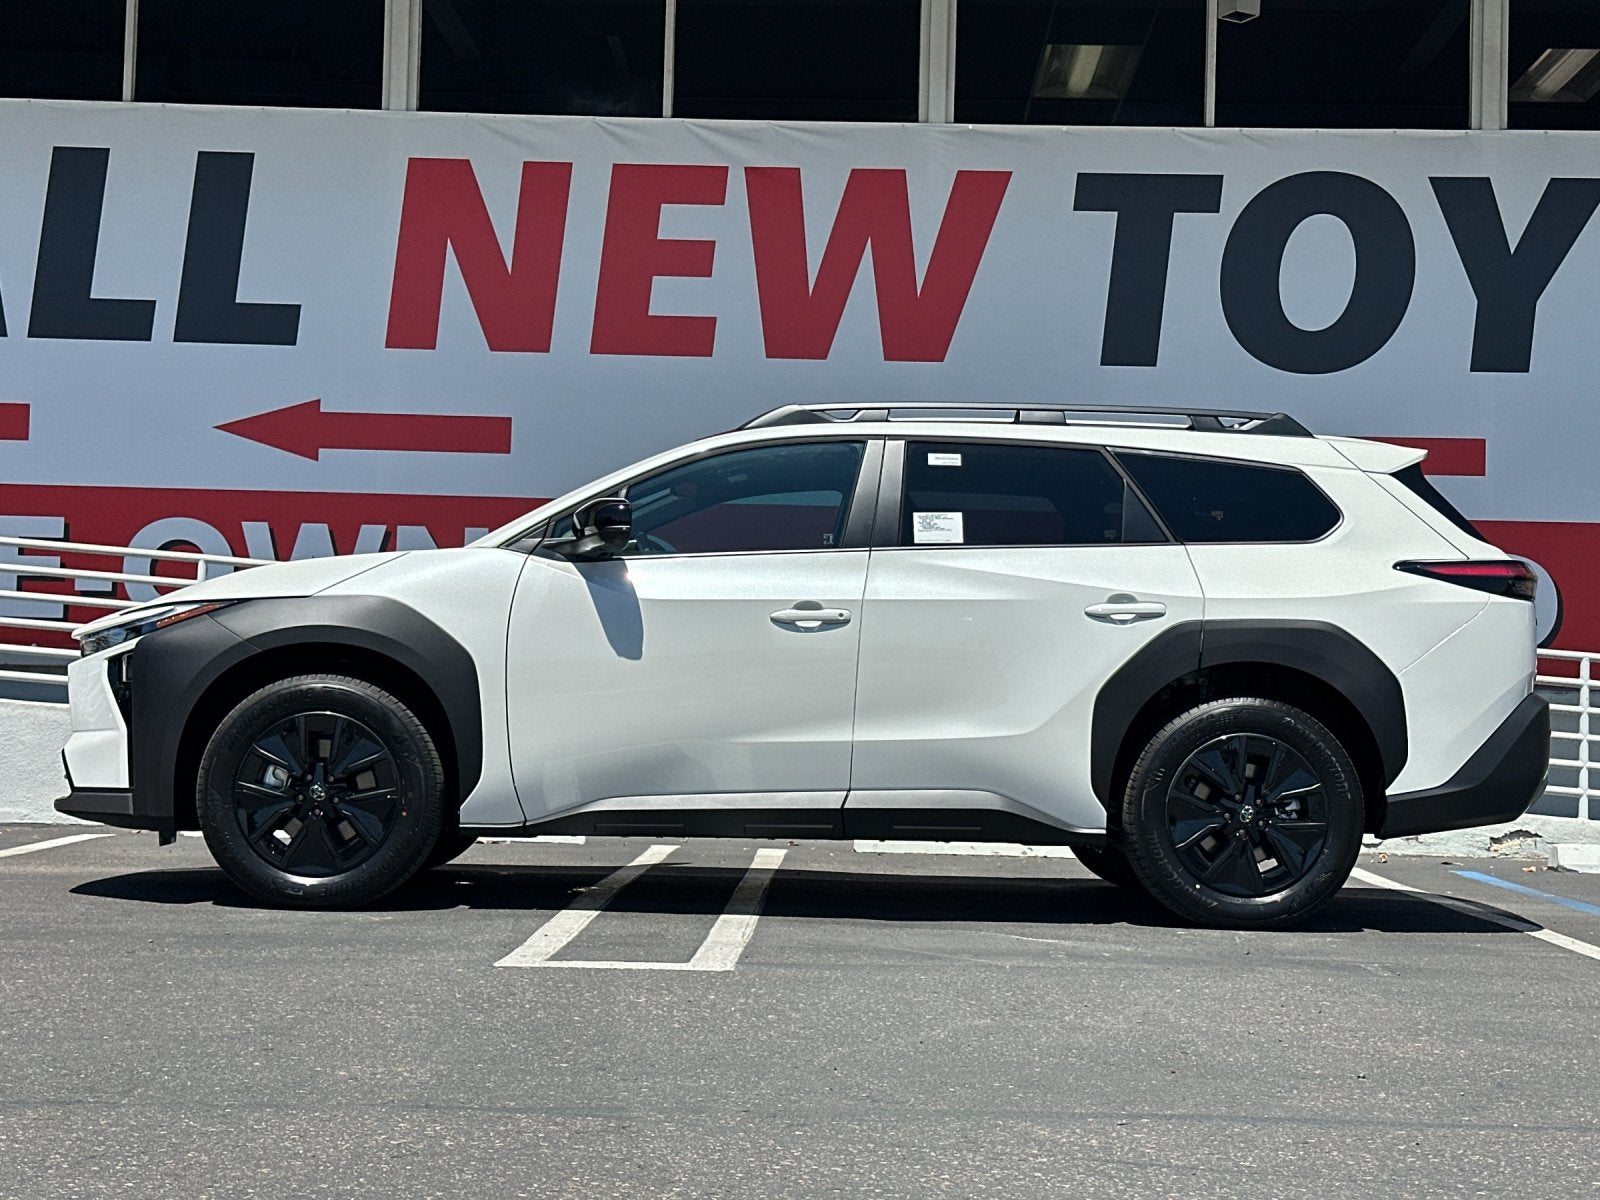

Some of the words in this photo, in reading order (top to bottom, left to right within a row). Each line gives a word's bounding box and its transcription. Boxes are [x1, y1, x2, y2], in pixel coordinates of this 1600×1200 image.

[0, 146, 301, 345] LL
[386, 158, 1012, 361] NEW
[1073, 171, 1600, 374] TOY
[0, 515, 480, 619] E-O
